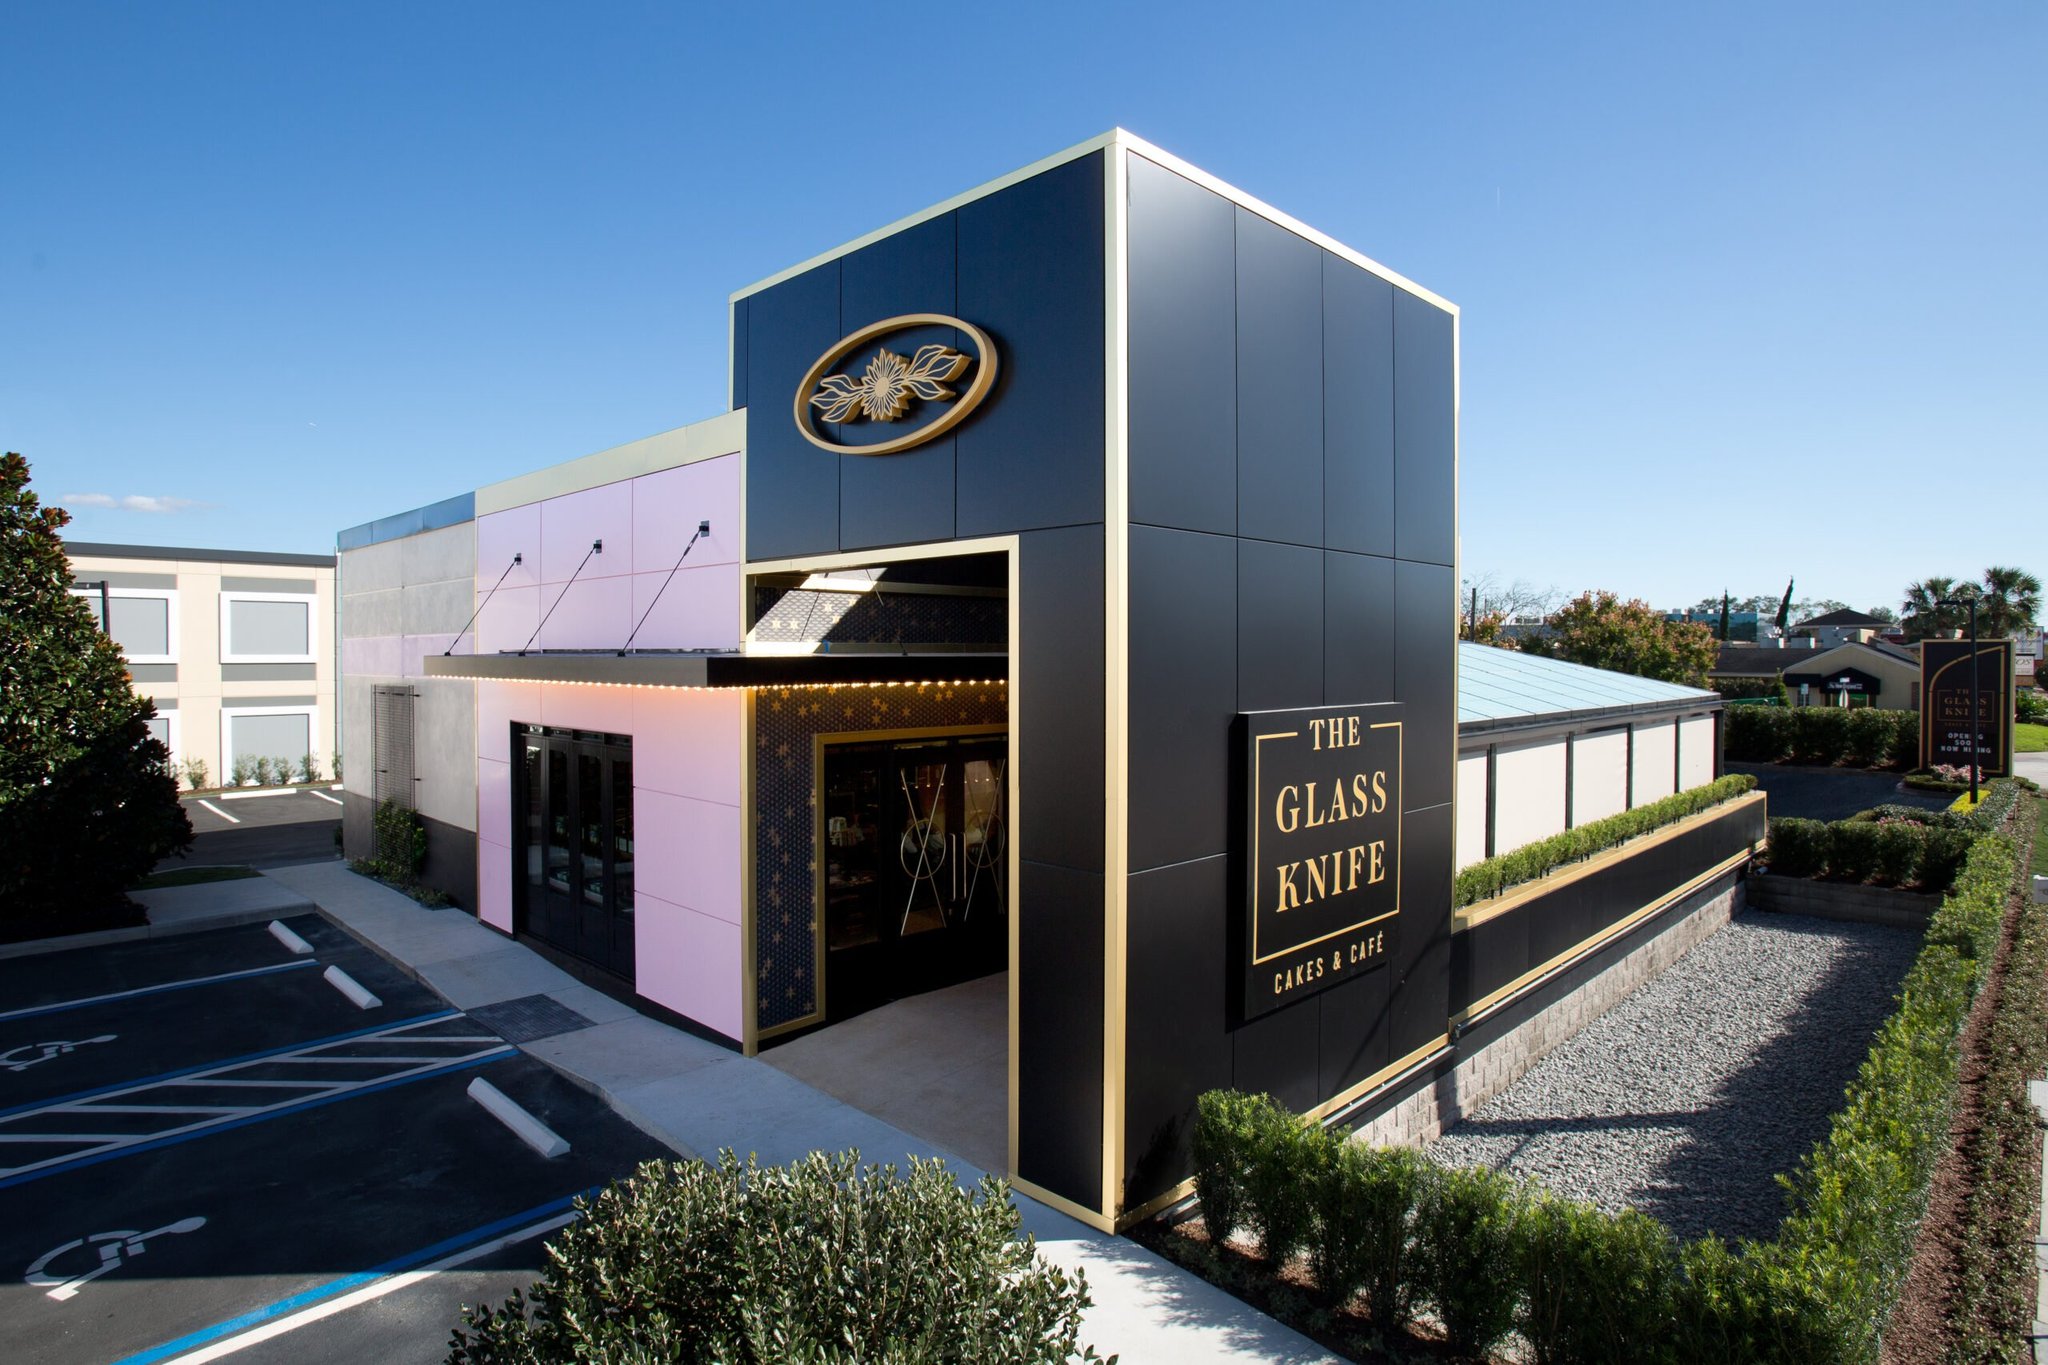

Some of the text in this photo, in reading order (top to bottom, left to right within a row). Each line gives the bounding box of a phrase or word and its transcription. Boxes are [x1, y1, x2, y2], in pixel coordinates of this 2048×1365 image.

[1944, 697, 1987, 705] GLAS
[1945, 707, 1986, 716] KNIE
[1309, 716, 1361, 751] THE
[1948, 732, 1983, 740] OPENG
[1963, 746, 1991, 754] HIING
[1275, 771, 1387, 833] GLASS
[1276, 840, 1386, 913] KNIFE
[1274, 930, 1384, 994] CAKES & CAFÉ
